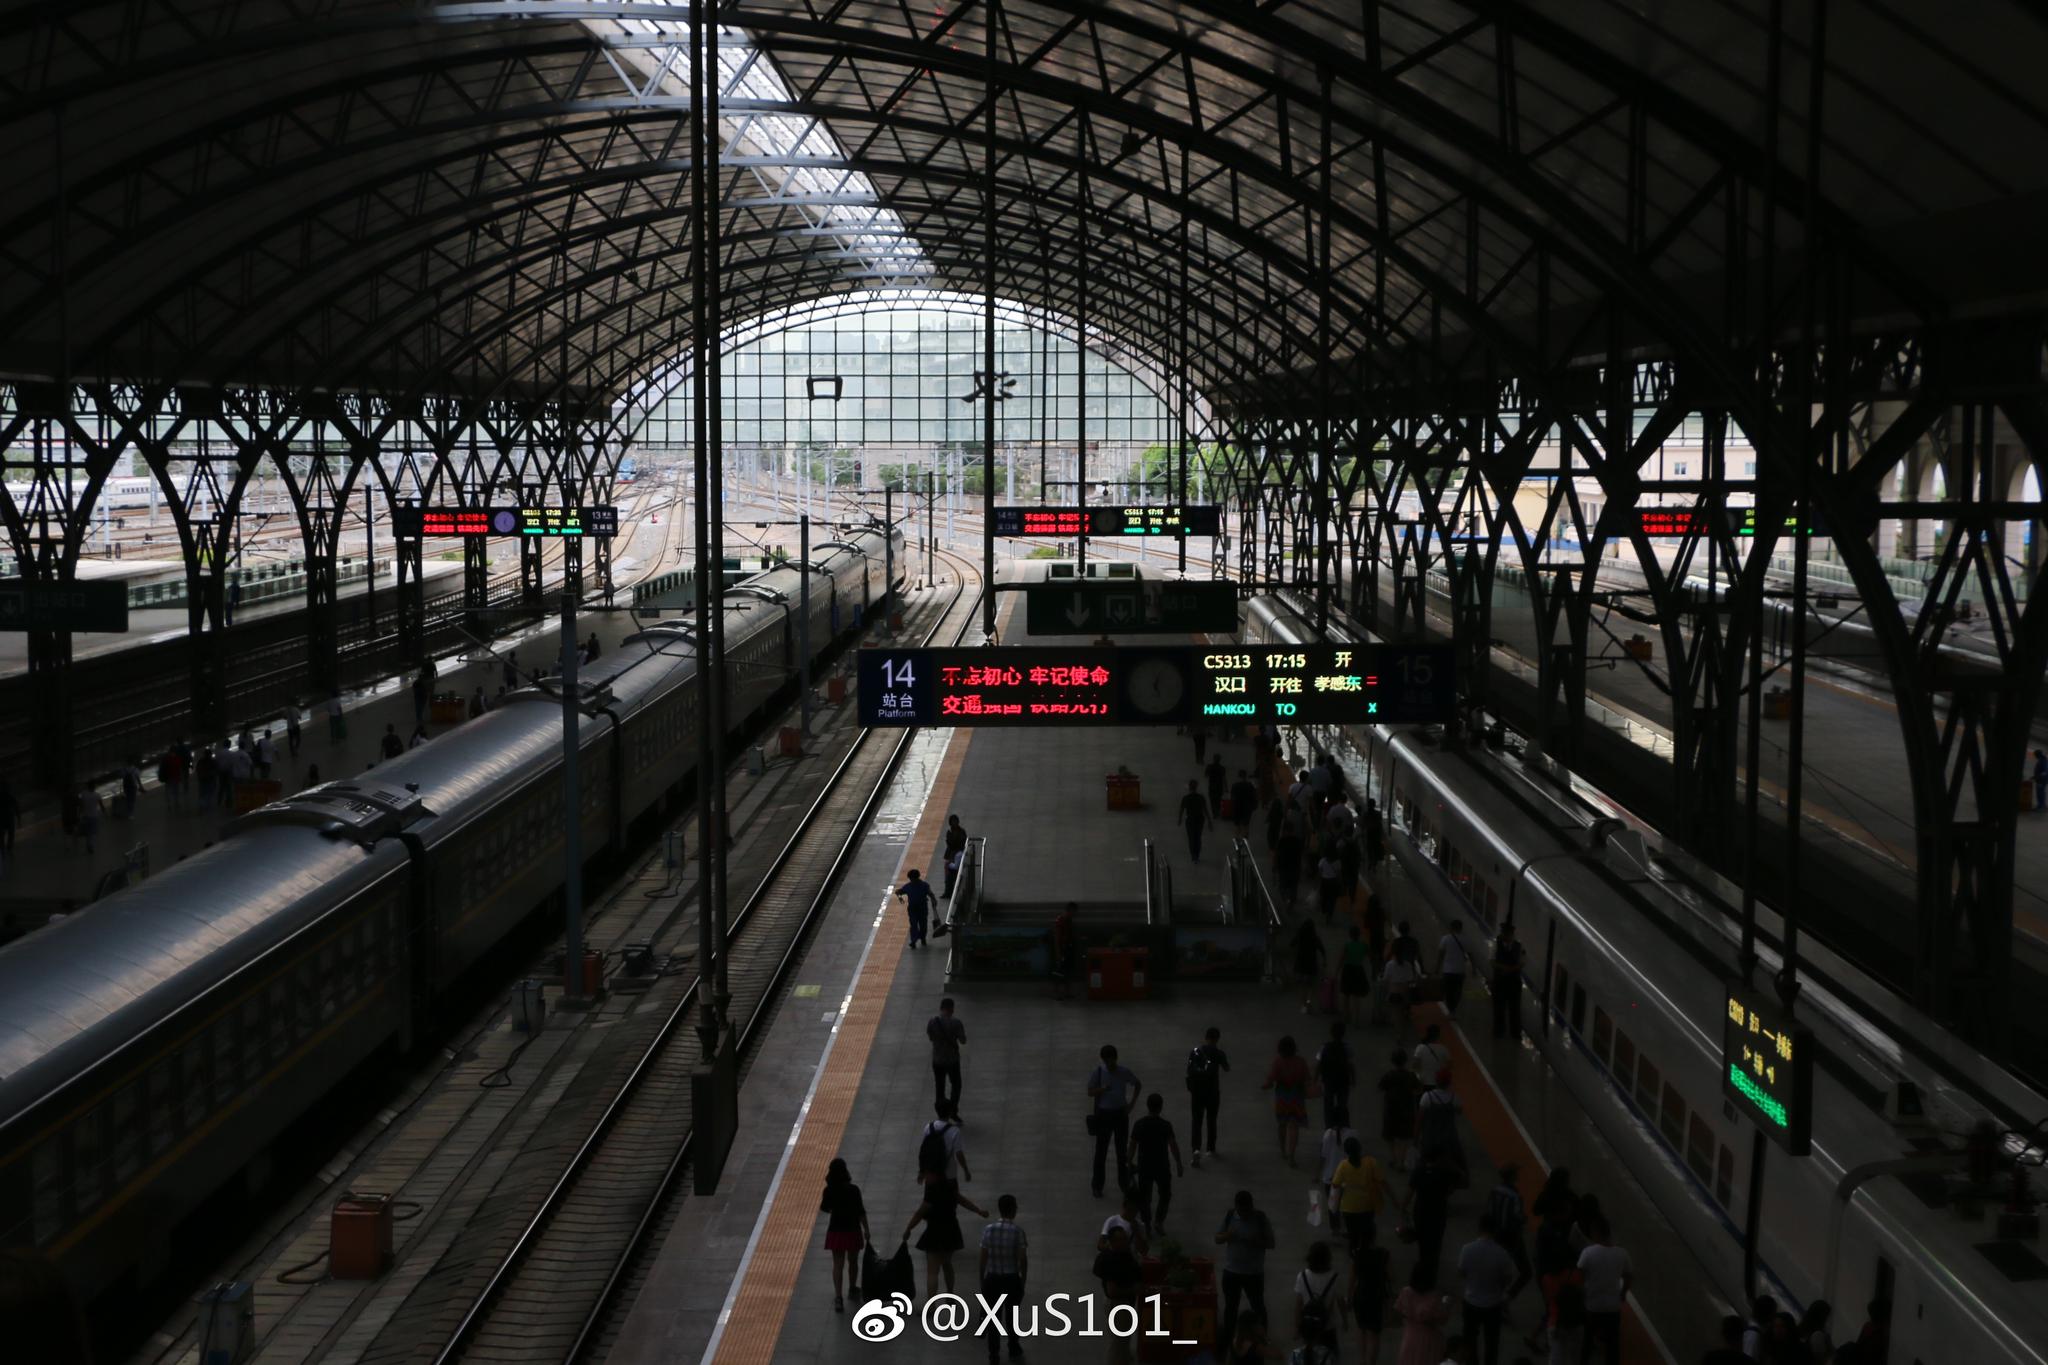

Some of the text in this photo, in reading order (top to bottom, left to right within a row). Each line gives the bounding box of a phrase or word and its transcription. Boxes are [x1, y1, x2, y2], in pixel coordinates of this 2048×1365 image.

[1203, 652, 1353, 669] C5313 17:15 开
[881, 659, 916, 688] 14
[942, 665, 1110, 687] 不忘初心 牢记使命
[1214, 675, 1362, 694] 汉口 开往 孝感东
[883, 693, 913, 708] 站台
[1203, 703, 1256, 715] HANKOU
[1275, 703, 1297, 715] TO
[878, 708, 916, 719] Platform
